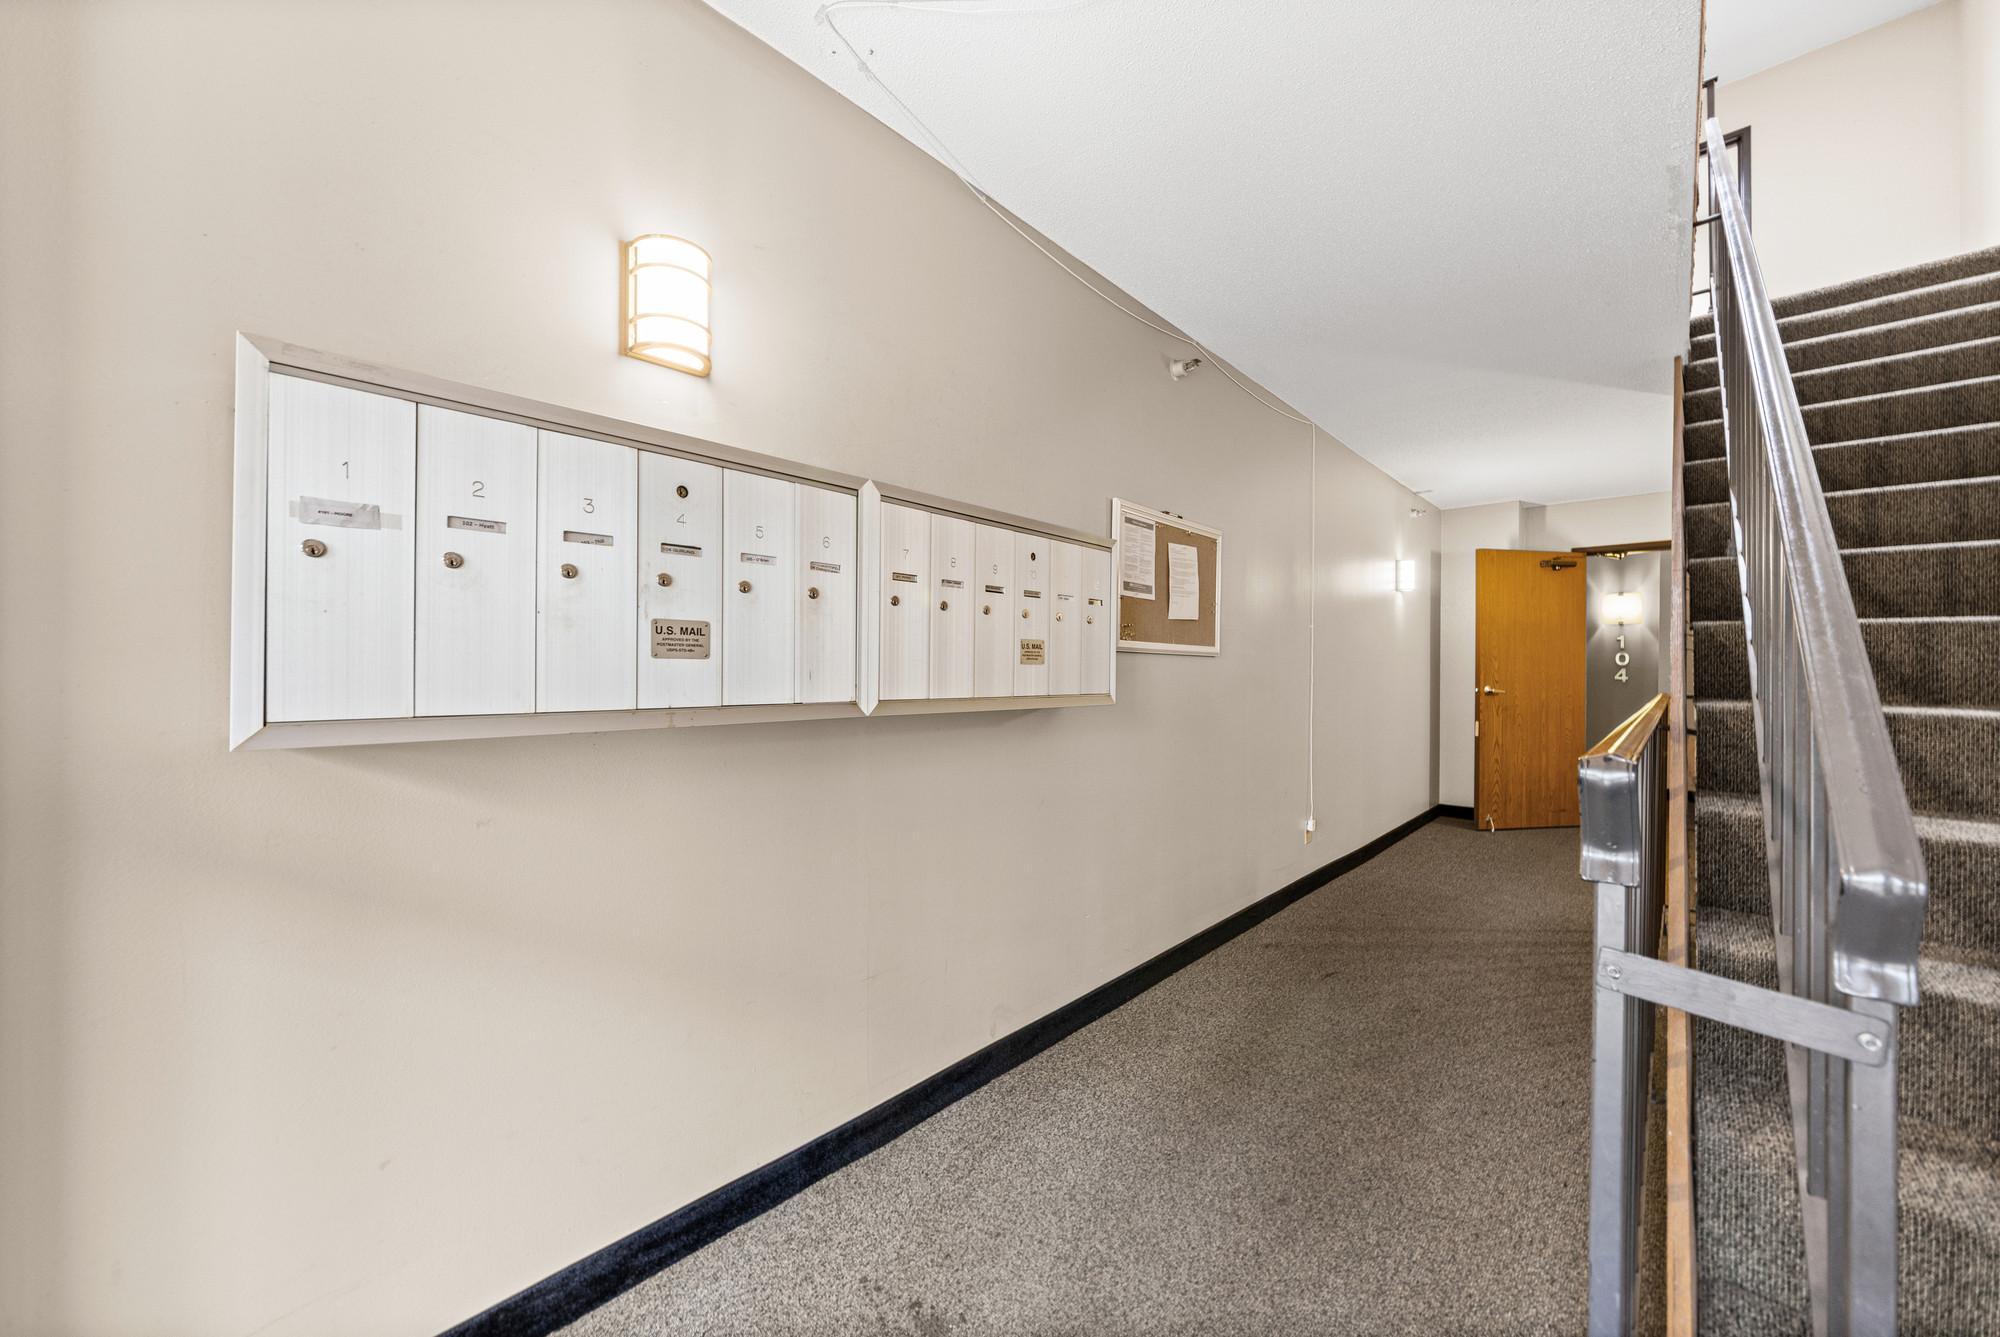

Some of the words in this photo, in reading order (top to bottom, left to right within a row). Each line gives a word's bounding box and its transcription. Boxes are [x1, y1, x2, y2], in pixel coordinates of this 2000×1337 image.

[341, 460, 349, 480] 1
[471, 480, 485, 498] 2
[583, 497, 595, 514] 3
[676, 513, 687, 528] 4
[755, 525, 765, 539] 5
[822, 536, 831, 549] 6
[903, 548, 910, 560] 7
[950, 557, 957, 568] 8
[655, 625, 677, 636] U.S.
[679, 626, 706, 637] MAIL
[1614, 635, 1630, 683] 104
